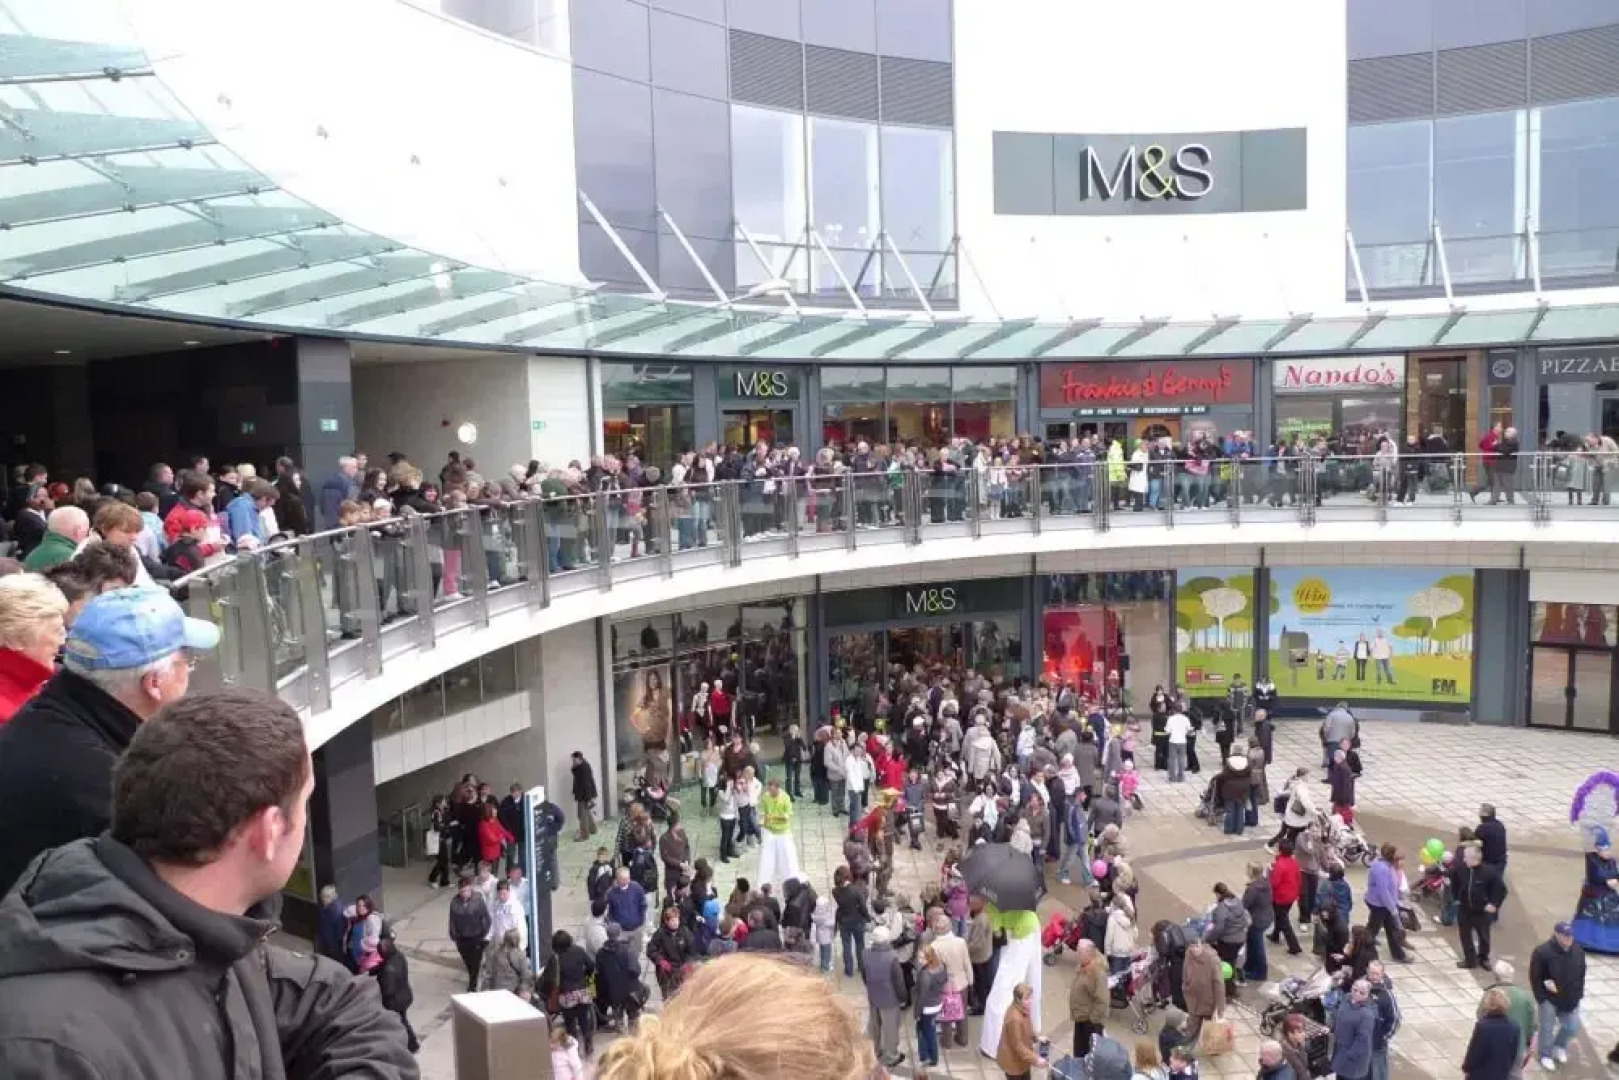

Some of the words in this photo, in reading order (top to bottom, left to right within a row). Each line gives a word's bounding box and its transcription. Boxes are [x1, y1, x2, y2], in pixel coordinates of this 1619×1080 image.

[1081, 143, 1214, 201] M&S
[736, 371, 788, 396] M&S
[1282, 361, 1396, 388] Nando's
[905, 587, 957, 613] M&S
